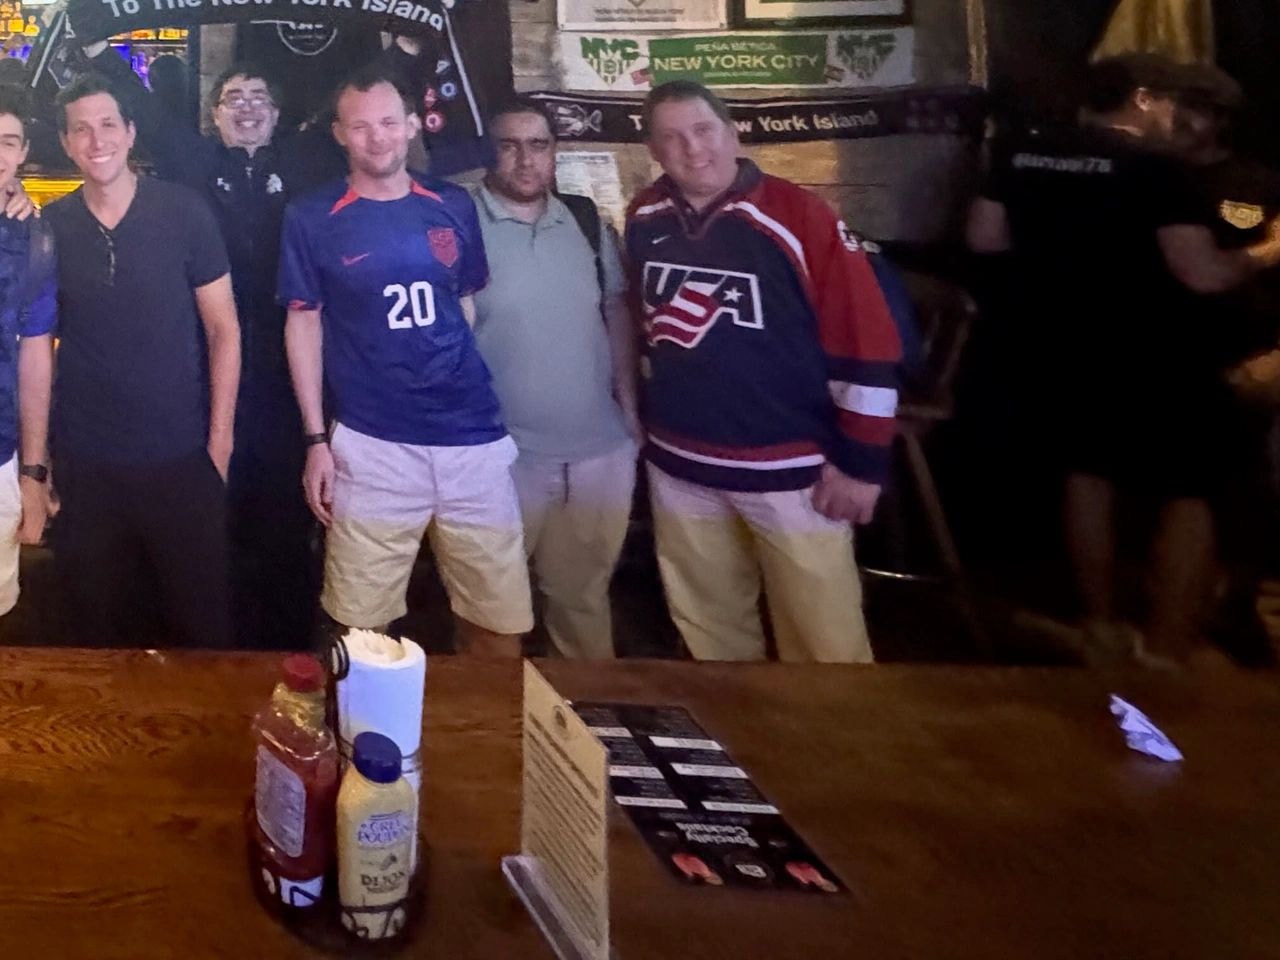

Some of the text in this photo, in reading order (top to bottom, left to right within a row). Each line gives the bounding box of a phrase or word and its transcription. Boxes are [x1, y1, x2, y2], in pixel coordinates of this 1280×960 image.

[654, 53, 818, 71] NEW YORK CITY
[628, 114, 643, 131] T
[757, 114, 808, 133] York
[813, 110, 879, 130] Island
[383, 281, 436, 329] 20
[644, 261, 764, 348] USA
